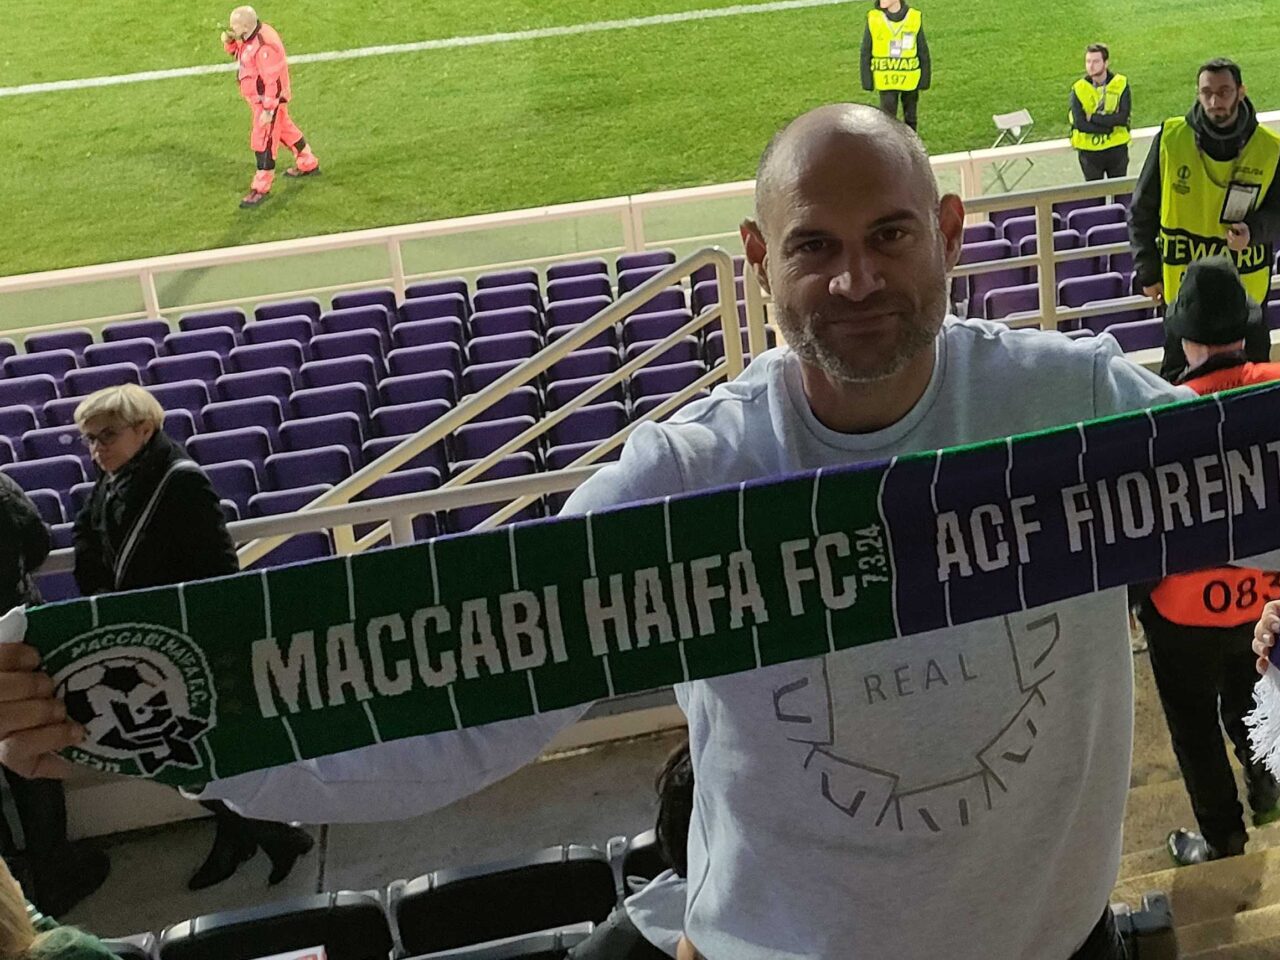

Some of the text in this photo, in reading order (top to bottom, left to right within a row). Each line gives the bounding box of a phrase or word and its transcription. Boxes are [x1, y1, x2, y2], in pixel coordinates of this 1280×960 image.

[883, 74, 907, 86] 197
[854, 523, 889, 588] 7.3.24
[937, 495, 1041, 582] ACF
[251, 530, 859, 719] MACCABI HAIFA FC
[863, 653, 978, 705] REAL
